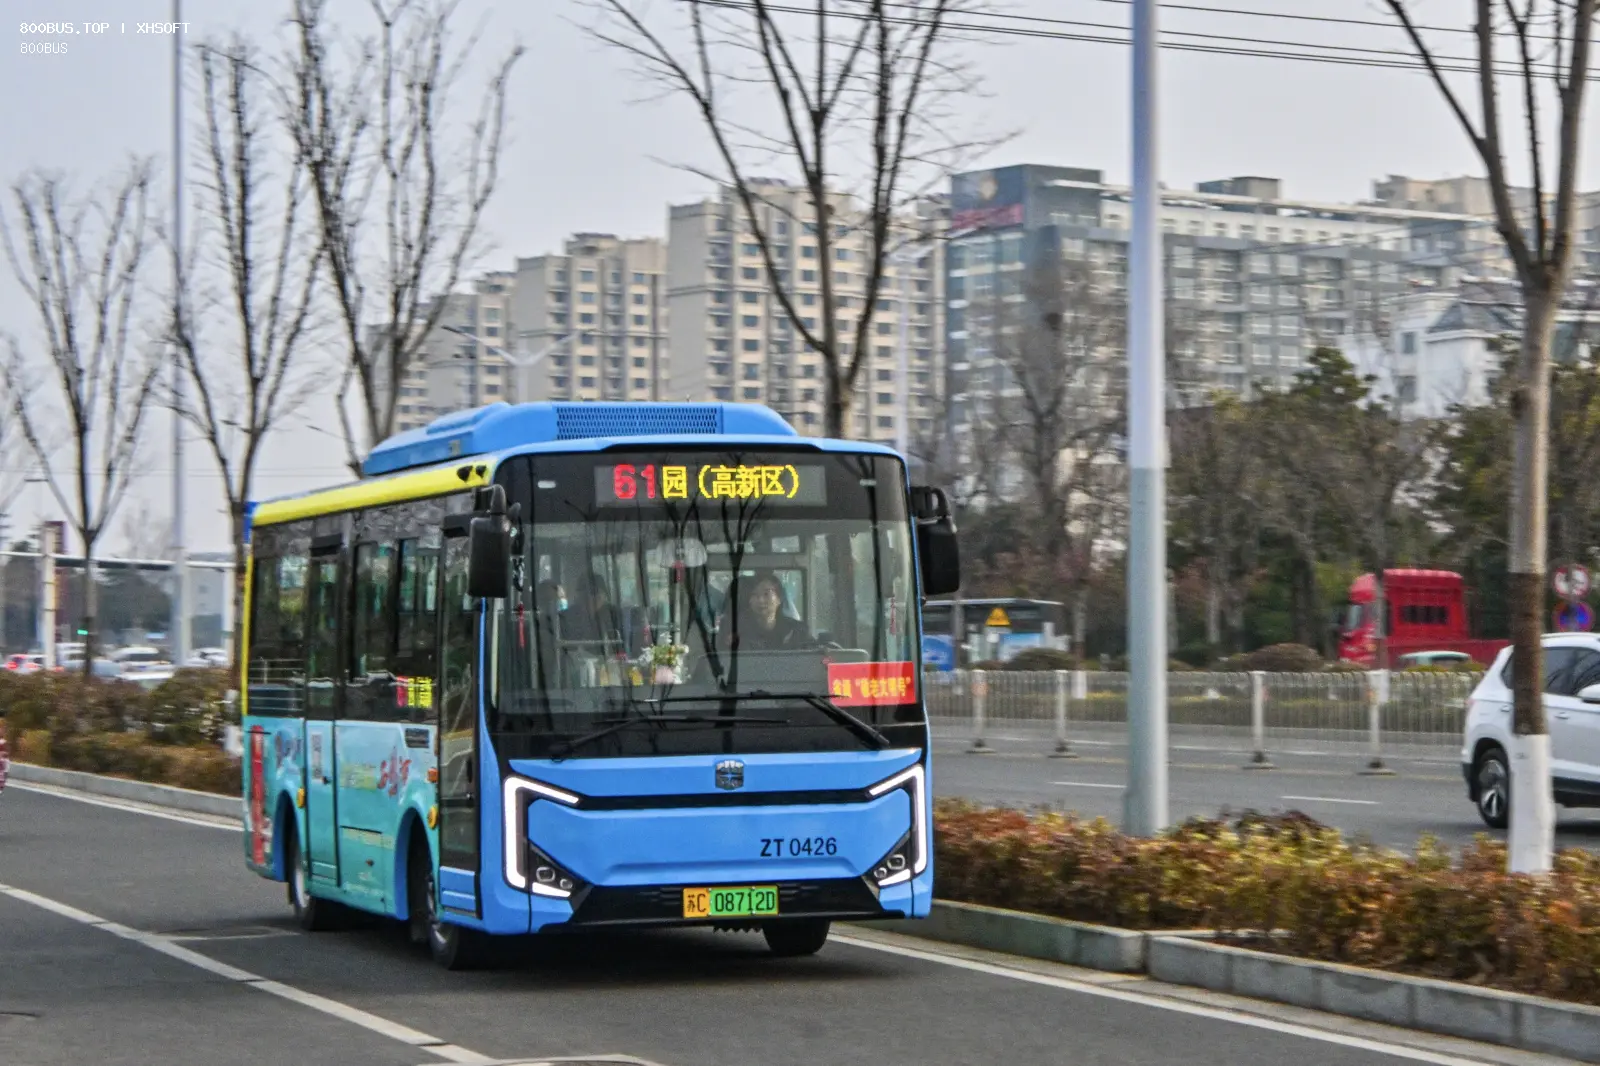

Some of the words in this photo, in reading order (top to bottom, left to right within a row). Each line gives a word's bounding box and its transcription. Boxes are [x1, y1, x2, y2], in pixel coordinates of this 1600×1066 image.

[613, 464, 656, 499] 61
[760, 838, 785, 857] ZT
[789, 837, 837, 856] 0426
